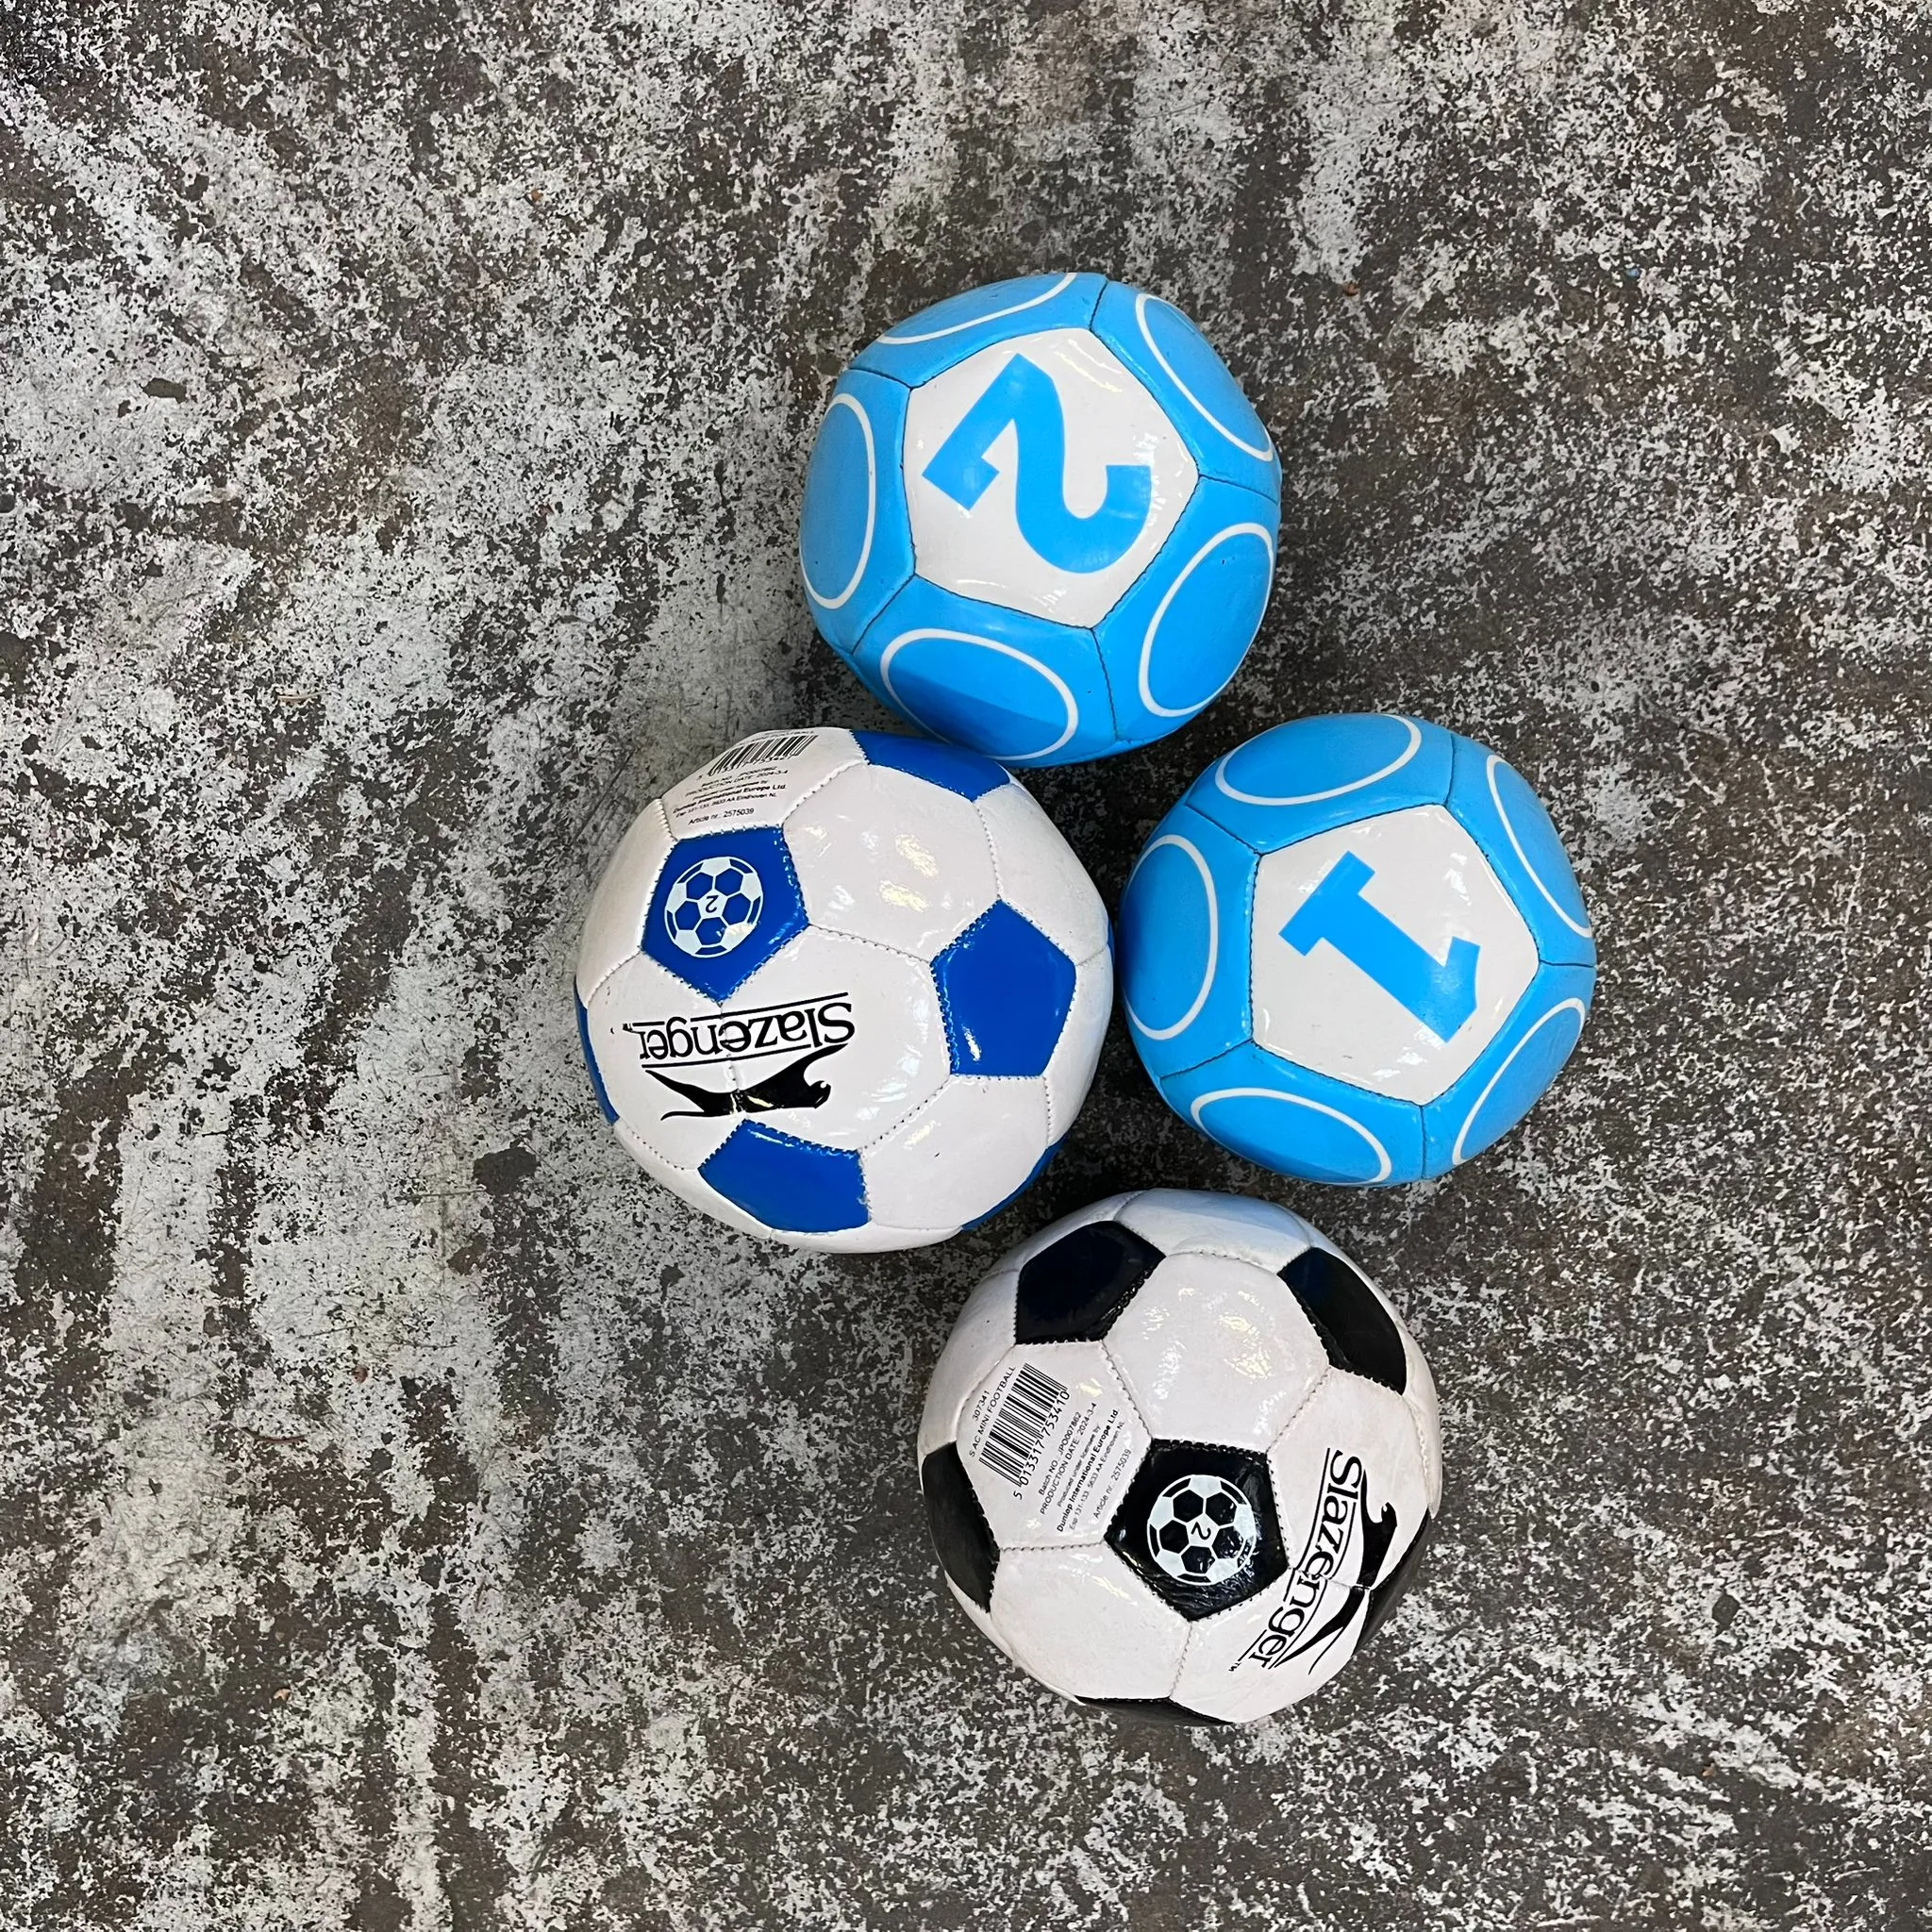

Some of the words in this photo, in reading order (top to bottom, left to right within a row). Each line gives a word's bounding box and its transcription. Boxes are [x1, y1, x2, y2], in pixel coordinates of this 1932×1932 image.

[922, 353, 1151, 574] 2
[688, 814, 709, 825] Article
[724, 808, 755, 818] 2575039
[705, 895, 719, 913] 2
[1278, 850, 1481, 1043] 1
[639, 1002, 856, 1060] Slazenger
[972, 1390, 990, 1422] 307341
[977, 1414, 991, 1435] MINI
[987, 1366, 1016, 1413] FOOTBALL
[1013, 1490, 1023, 1500] 5
[1019, 1439, 1045, 1487] 013317
[1041, 1391, 1070, 1436] 753410
[1040, 1460, 1068, 1515] PRODUCTION
[1077, 1403, 1096, 1435] 2024-3-4
[1057, 1503, 1074, 1532] Dunlop
[1069, 1453, 1096, 1502] International
[1093, 1425, 1111, 1454] Europe
[1038, 1474, 1052, 1496] Batch
[1092, 1495, 1108, 1519] Article
[1110, 1448, 1132, 1481] 2575039
[1191, 1521, 1212, 1541] 2
[1248, 1449, 1362, 1669] Slazenger
